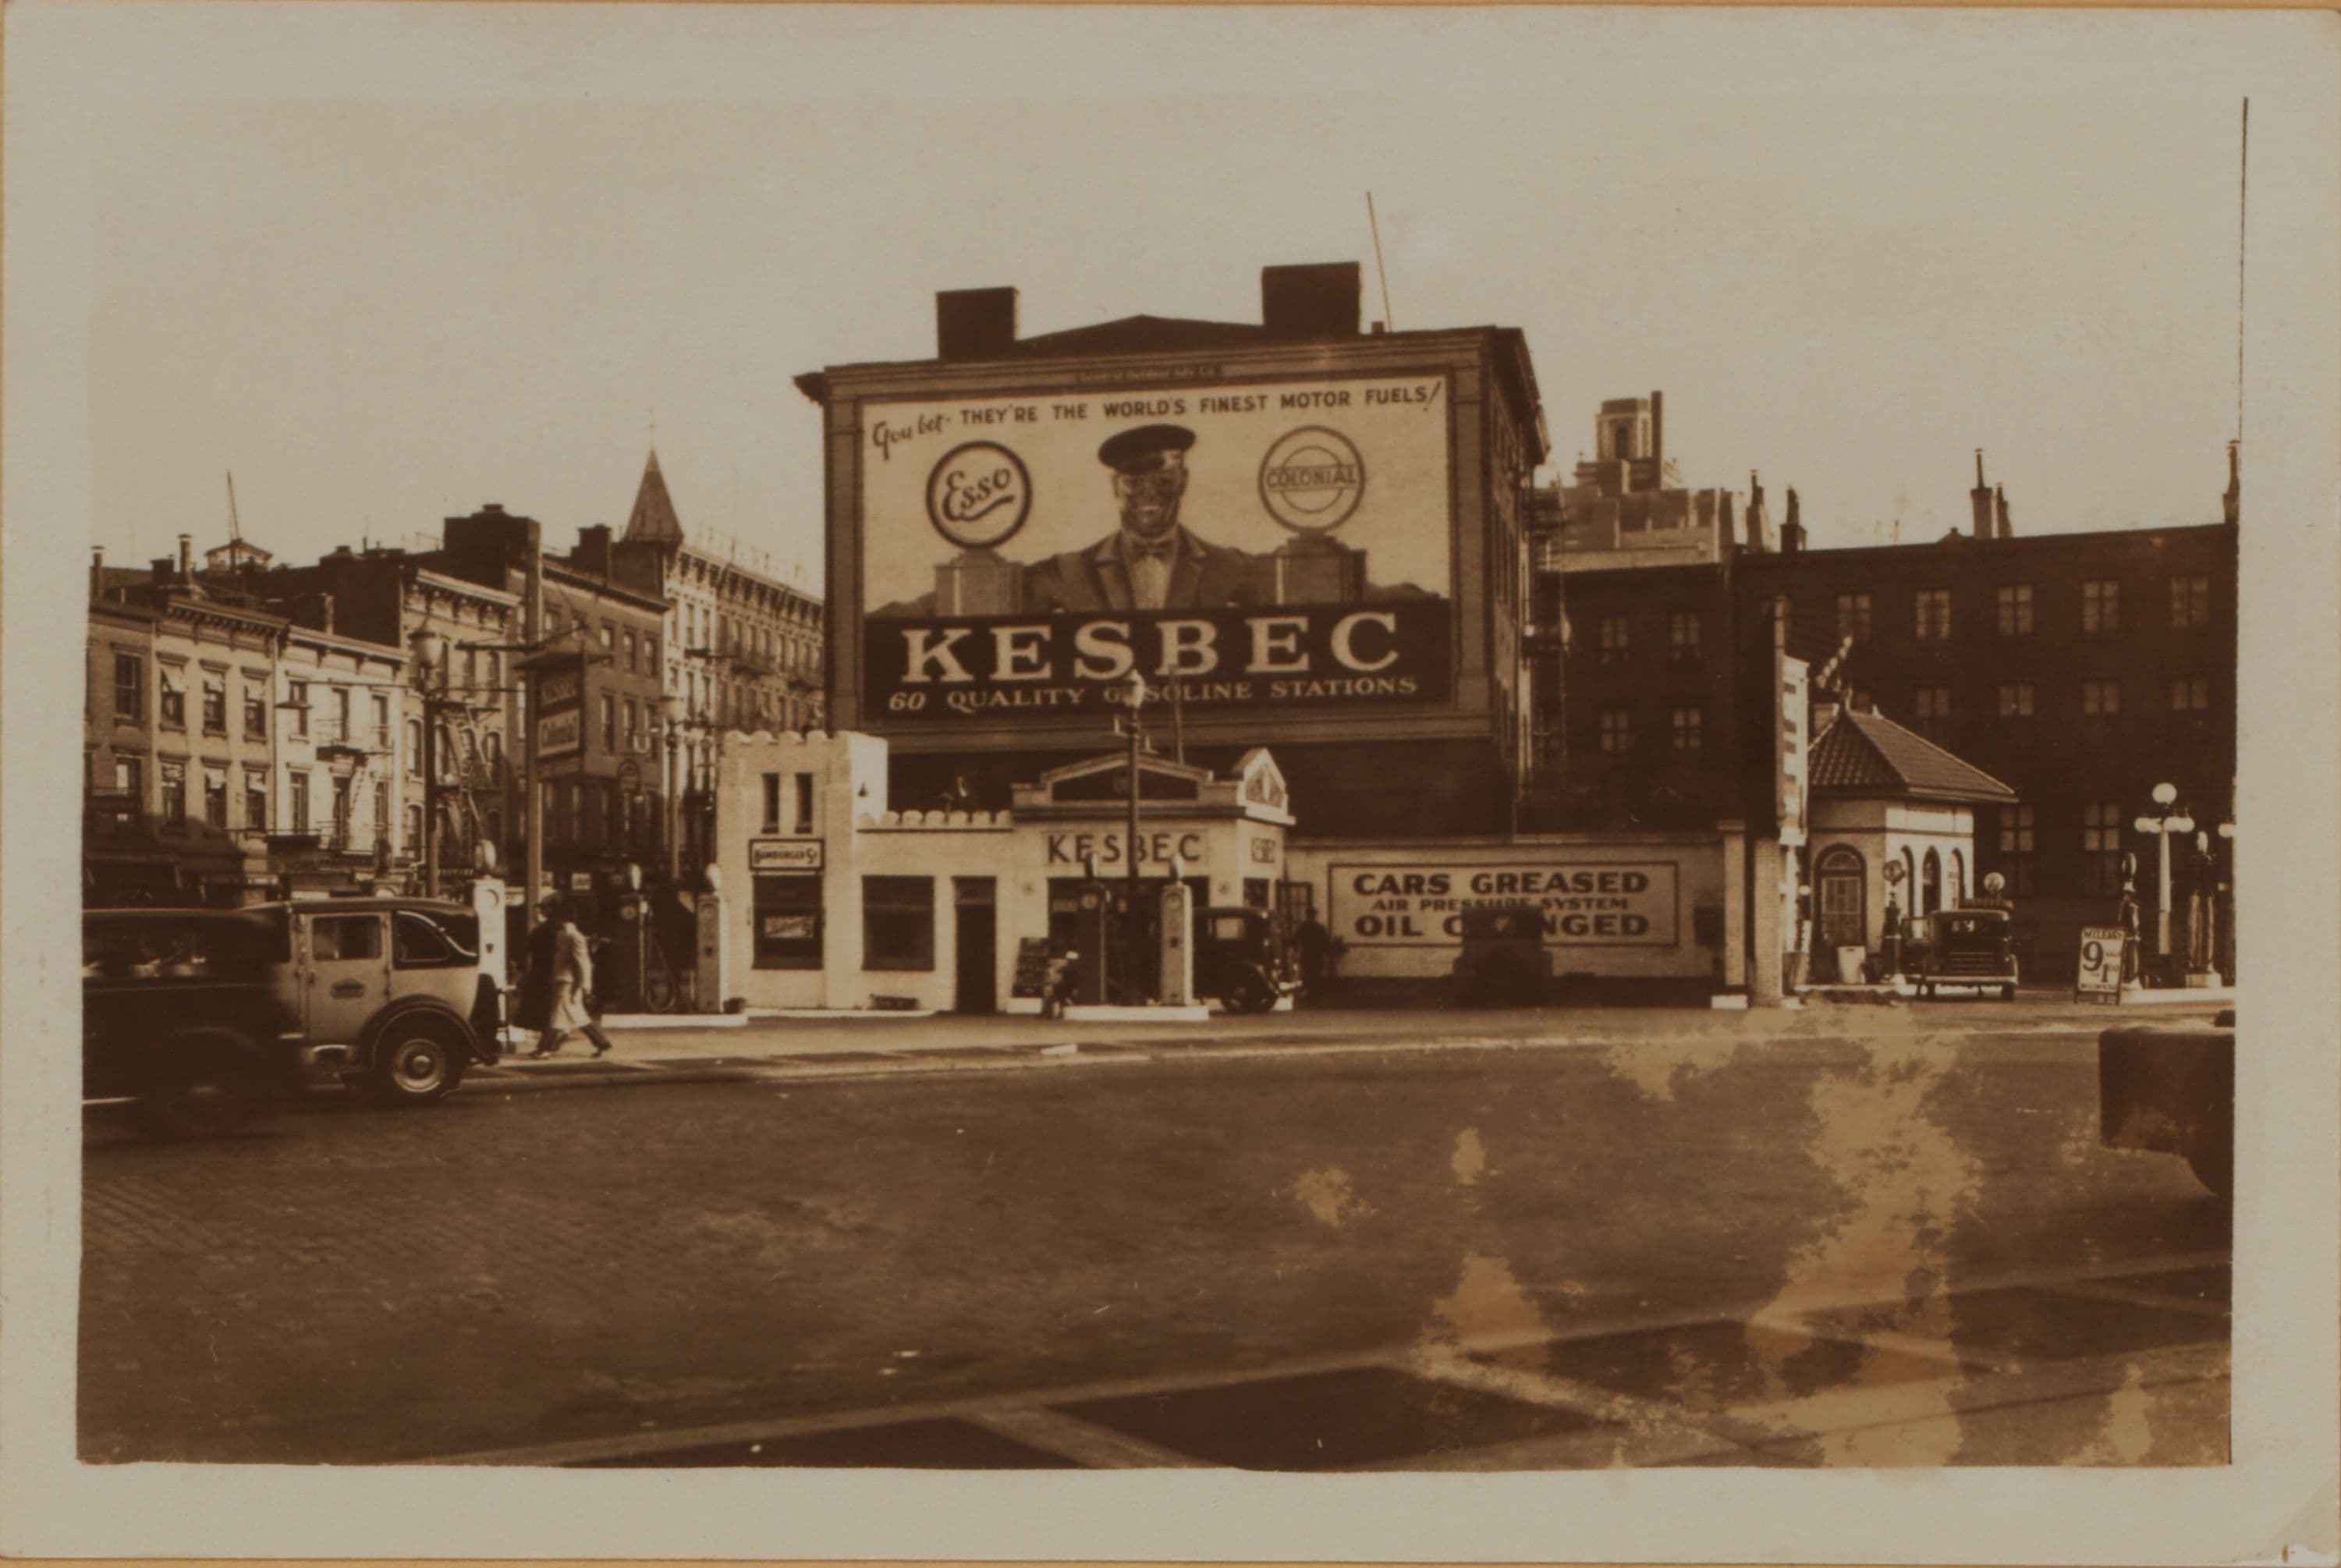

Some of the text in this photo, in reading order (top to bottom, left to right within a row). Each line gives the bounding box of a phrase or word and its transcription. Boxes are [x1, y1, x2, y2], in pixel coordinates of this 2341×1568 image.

[960, 404, 1039, 425] THEY'RE
[1052, 404, 1088, 421] THE
[1102, 398, 1186, 418] WORLD'S
[1199, 395, 1269, 414] FINEST
[1280, 391, 1351, 410] MOTOR
[1365, 381, 1442, 413] FUELS!
[1266, 466, 1357, 489] COLONIAL
[942, 468, 1016, 522] Esso
[901, 613, 1399, 683] KESBEC
[889, 676, 1418, 715] 60 QUALITY GSOLINE STATIONS
[1353, 871, 1650, 897] CARS GREASED
[1371, 899, 1410, 912] AIR
[1541, 897, 1630, 911] SYSTEM
[1354, 915, 1425, 938] OIL
[2082, 941, 2105, 972] 9
